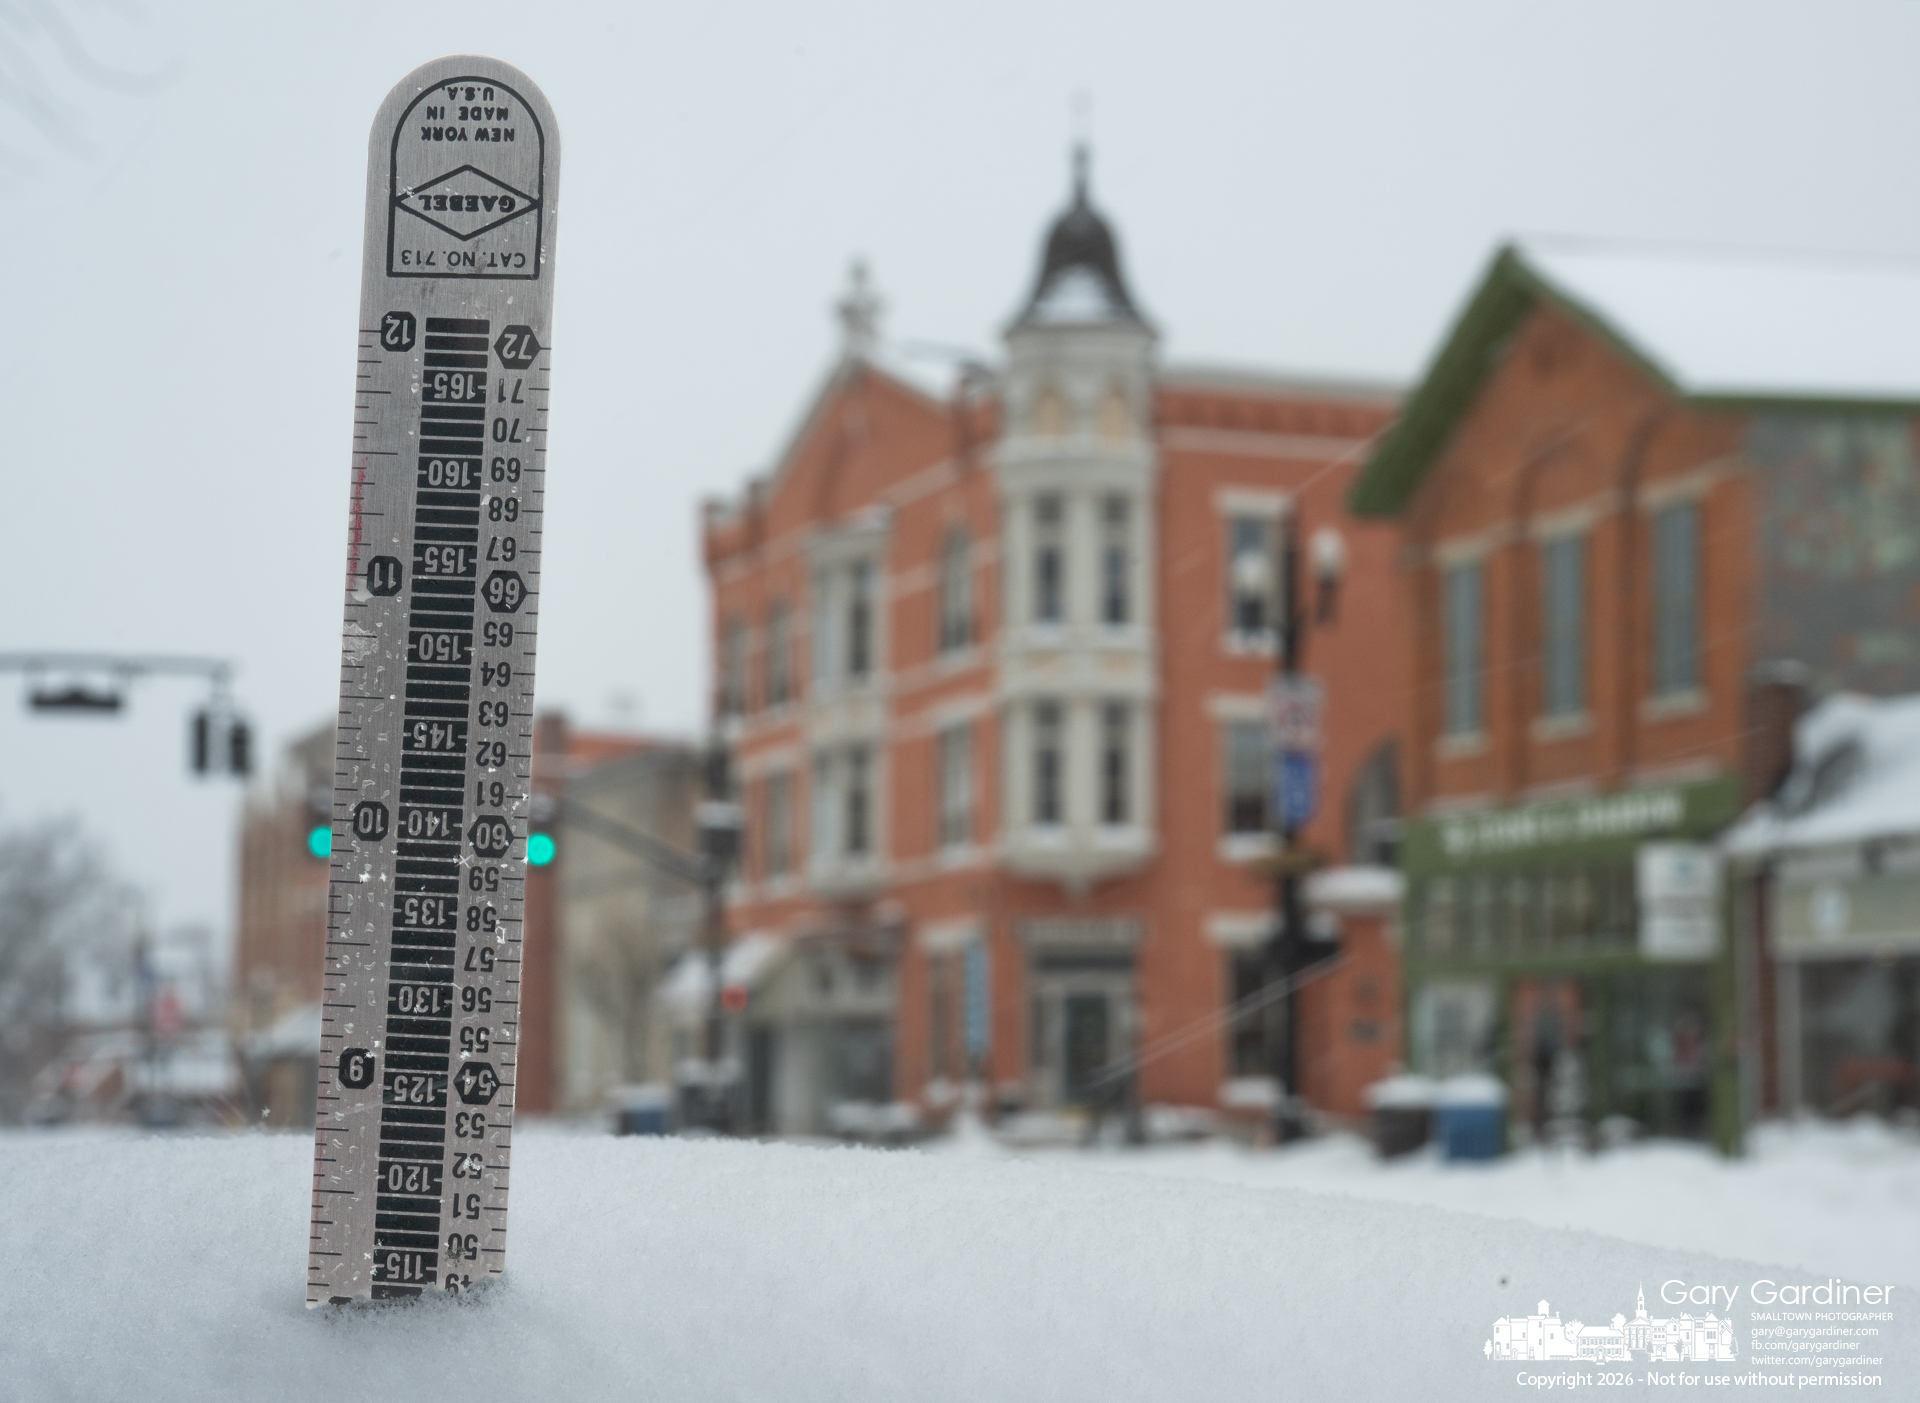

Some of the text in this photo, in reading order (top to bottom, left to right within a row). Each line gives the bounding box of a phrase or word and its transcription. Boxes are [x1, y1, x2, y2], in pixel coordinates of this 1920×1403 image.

[442, 86, 494, 101] U.S.A.
[427, 106, 509, 121] MADE IN
[421, 127, 515, 142] NEW YORK
[418, 195, 516, 212] GAEBEL
[401, 250, 526, 268] CAT. NO. 713
[385, 319, 411, 345] 12
[502, 333, 532, 360] 72
[434, 373, 476, 399] 165
[498, 378, 524, 404] 71
[492, 417, 522, 443] 70
[428, 460, 470, 487] 160
[491, 457, 521, 483] 69
[488, 497, 519, 522] 68
[424, 547, 467, 573] 155
[486, 537, 517, 562] 67
[374, 563, 396, 589] 11
[489, 578, 520, 605] 66
[418, 634, 461, 661] 150
[483, 622, 513, 647] 65
[480, 662, 511, 687] 64
[478, 701, 508, 727] 63
[413, 722, 455, 749] 145
[476, 741, 506, 767] 62
[476, 781, 504, 807] 61
[359, 807, 384, 834] 10
[408, 810, 449, 837] 140
[476, 823, 507, 849] 60
[469, 866, 499, 892] 59
[404, 898, 446, 925] 135
[466, 906, 497, 932] 58
[464, 946, 494, 972] 57
[398, 986, 441, 1014] 130
[461, 986, 492, 1013] 56
[460, 1026, 490, 1053] 55
[350, 1056, 364, 1082] 9
[394, 1075, 435, 1104] 125
[462, 1069, 492, 1096] 54
[455, 1112, 485, 1139] 53
[388, 1165, 430, 1192] 120
[452, 1152, 483, 1179] 52
[453, 1193, 480, 1219] 51
[447, 1233, 478, 1260] 50
[386, 1252, 424, 1280] 115
